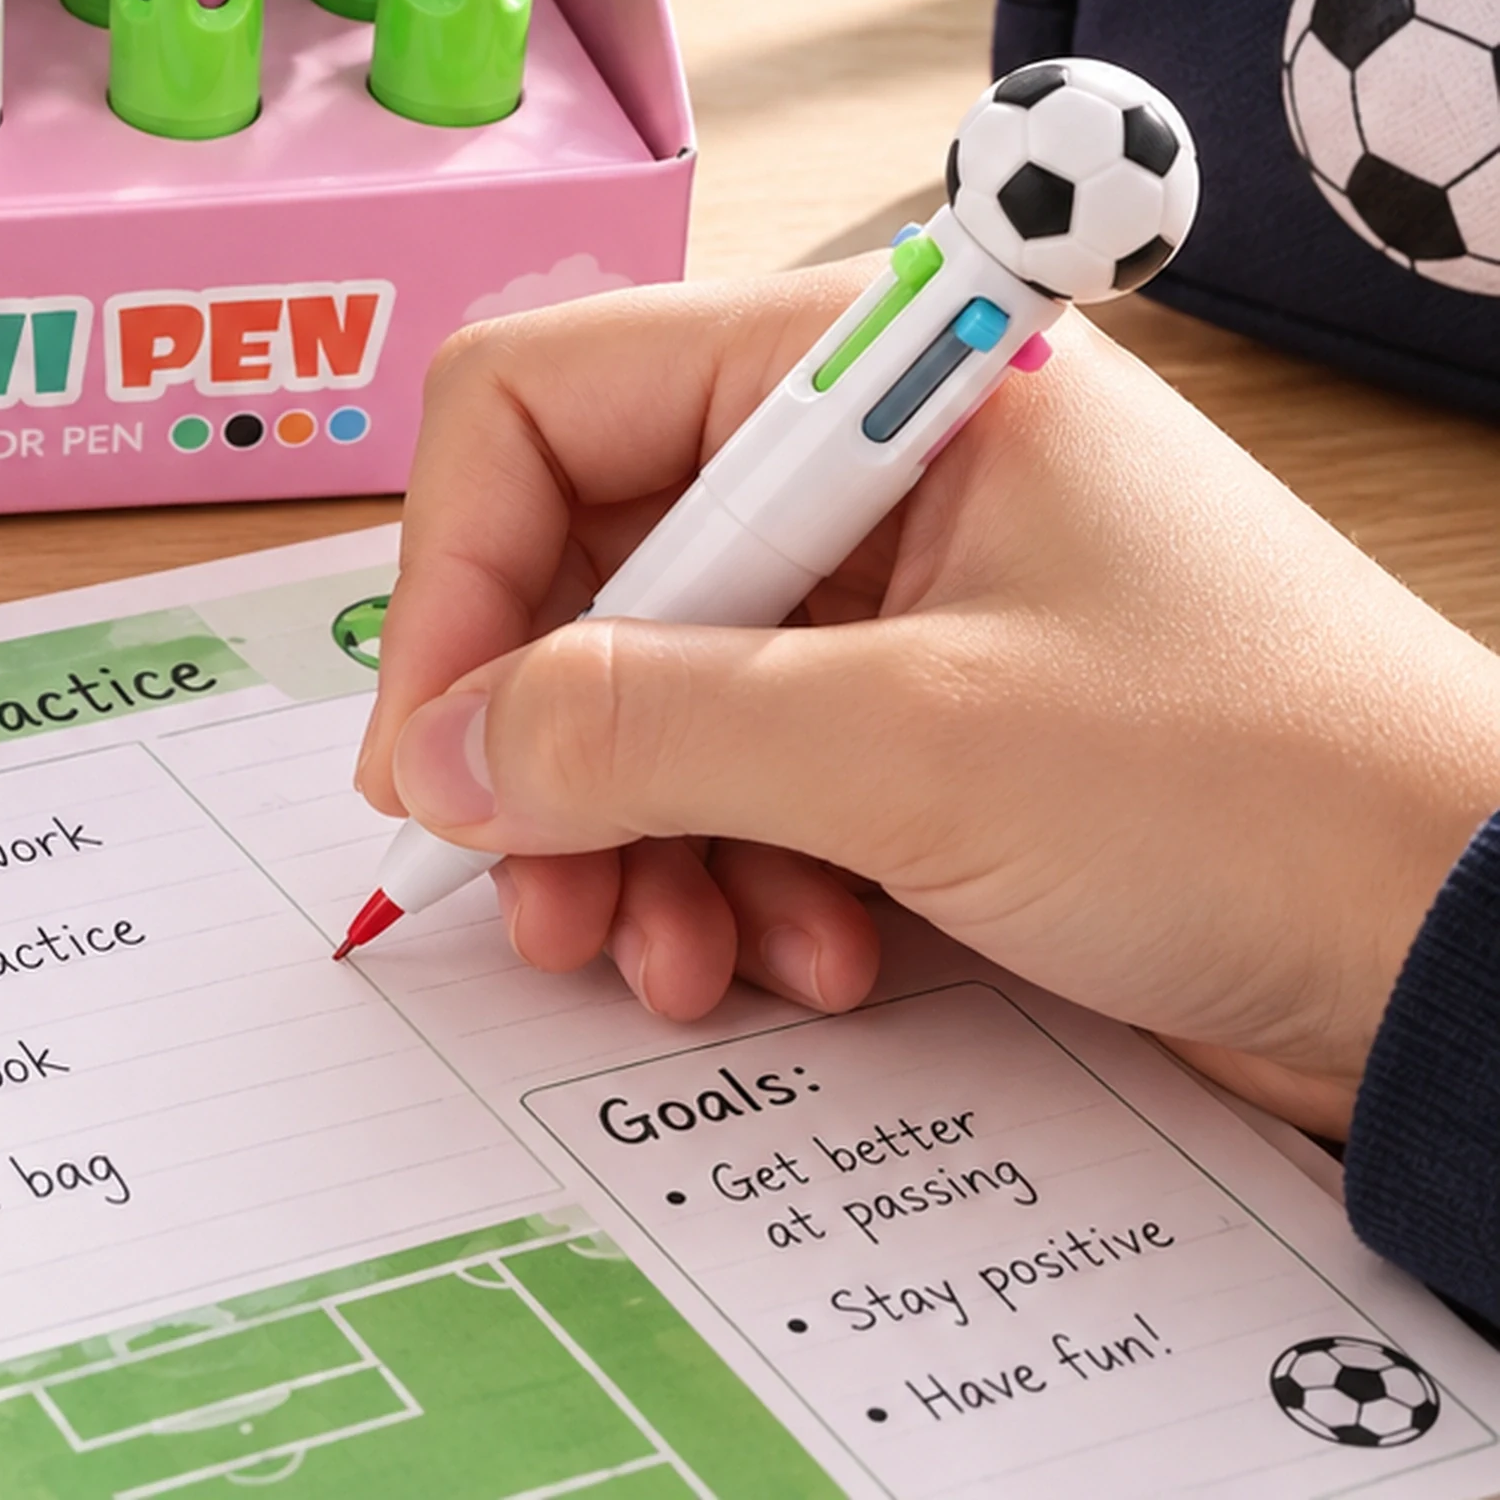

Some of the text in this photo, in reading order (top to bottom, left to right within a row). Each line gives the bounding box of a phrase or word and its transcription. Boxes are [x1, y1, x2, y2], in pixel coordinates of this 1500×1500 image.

[118, 293, 379, 389] PEN
[62, 422, 144, 456] PEN
[598, 1062, 821, 1146] Goals:
[9, 1153, 131, 1205] bag
[712, 1110, 976, 1203] Get better
[767, 1161, 1039, 1251] at passing
[830, 1222, 1175, 1332] Stay positive
[904, 1313, 1173, 1421] Have fun!
